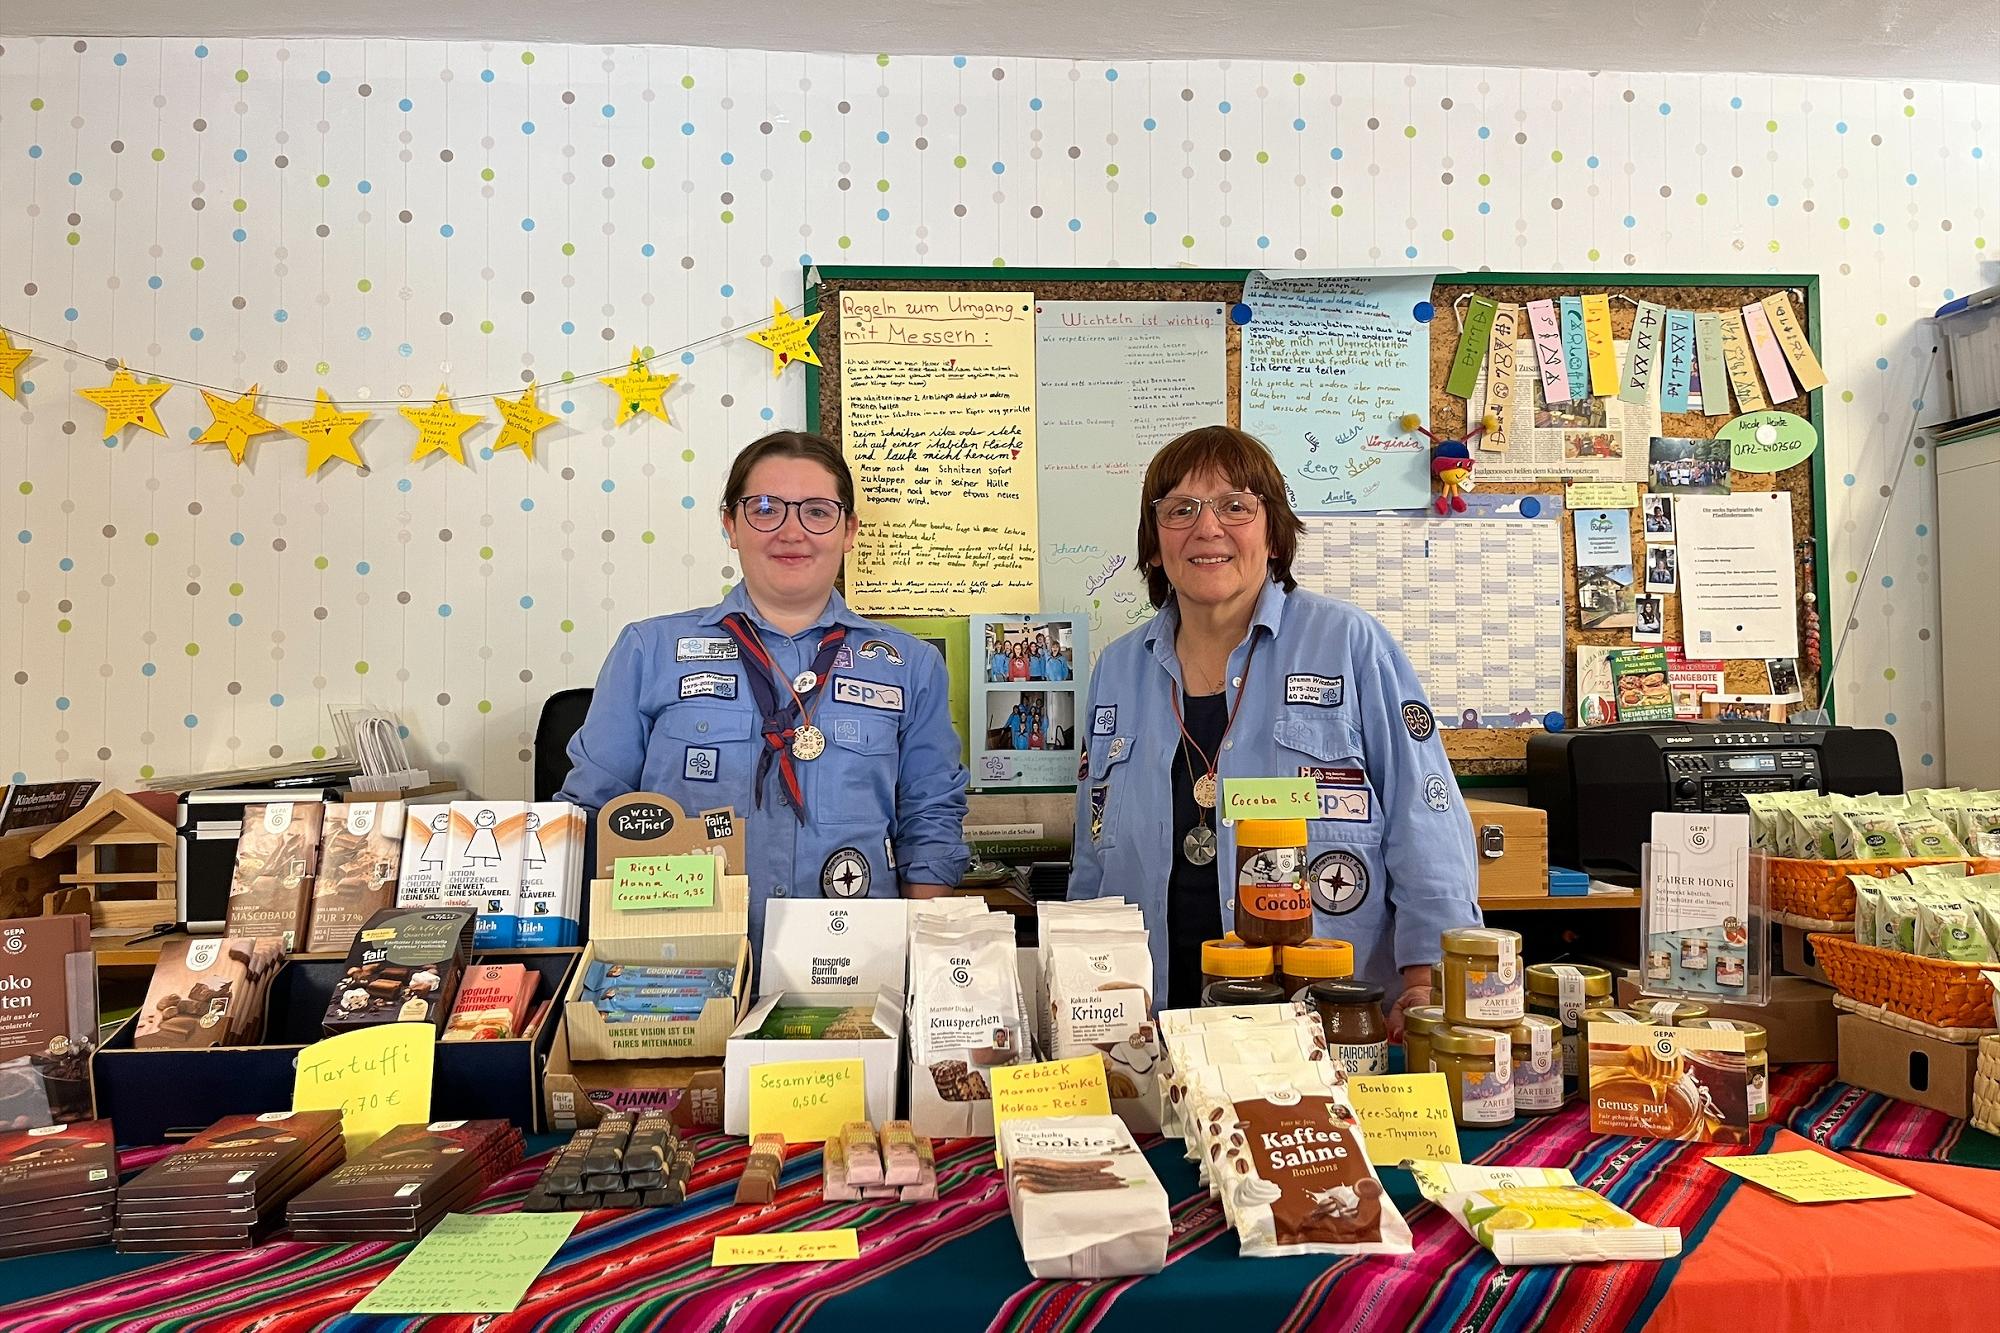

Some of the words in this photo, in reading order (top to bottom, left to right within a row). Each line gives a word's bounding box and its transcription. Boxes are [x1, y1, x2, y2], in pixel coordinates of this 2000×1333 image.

[842, 296, 896, 322] Regeln
[906, 304, 939, 315] zum
[948, 295, 1013, 322] Umgang
[1061, 312, 1133, 327] Wichteln
[1141, 314, 1158, 326] ist
[1166, 314, 1214, 329] wichtig:
[844, 323, 878, 340] mit
[1290, 337, 1314, 347] mich
[1315, 349, 1334, 357] und
[1360, 349, 1381, 357] mich
[1309, 356, 1326, 364] und
[1250, 363, 1266, 373] Ich
[1269, 364, 1291, 373] lerne
[1315, 365, 1346, 375] teilen
[1251, 377, 1263, 386] Ich
[1296, 392, 1311, 401] und
[1321, 393, 1339, 402] das
[881, 427, 926, 439] Schnitzen
[1366, 435, 1421, 450] Virginia
[854, 451, 876, 461] und
[939, 464, 982, 475] Schnitzen
[988, 466, 1012, 475] sofort
[1303, 460, 1328, 473] Lea
[935, 477, 943, 486] in
[986, 478, 1009, 488] Hülle
[1085, 554, 1123, 590] Charlotte
[1669, 673, 1718, 682] SANGEBOTE
[837, 682, 876, 702] rsp
[1300, 694, 1319, 702] Jahre
[1621, 708, 1673, 718] HEIMSERVICE
[1231, 793, 1277, 806] Cocoba
[630, 808, 663, 817] WELT
[618, 816, 672, 831] Partner
[714, 825, 732, 838] bio
[630, 863, 671, 876] Riegel
[620, 879, 662, 887] Hanna
[676, 873, 704, 884] 1,70
[1657, 875, 1695, 886] FAIRER
[1698, 878, 1734, 888] HONIG
[683, 887, 705, 898] 1,95
[1255, 893, 1311, 911] Cocoba
[232, 911, 296, 922] MASCOBADO
[317, 913, 337, 923] PUR
[340, 912, 363, 922] 37%
[4, 928, 26, 936] GEPA
[362, 950, 388, 961] fair
[812, 957, 851, 967] Knusprige
[950, 957, 971, 966] GEPA
[811, 975, 859, 986] Sesamriegel
[462, 987, 493, 997] yogurt
[460, 995, 513, 1004] strawberry
[1071, 996, 1088, 1004] Kokos
[1484, 998, 1510, 1006] ZARTE
[1072, 1003, 1124, 1023] Kringel
[930, 1014, 1000, 1030] Knusperchen
[609, 1028, 639, 1037] UNSERE
[640, 1028, 666, 1036] VISION
[668, 1027, 681, 1035] IST
[683, 1027, 695, 1035] EIN
[1653, 1030, 1677, 1038] GEPA
[613, 1040, 639, 1048] FAIRES
[641, 1039, 695, 1048] MITEINANDER.
[304, 1045, 411, 1084] Tartuffi
[1013, 1062, 1070, 1080] Gebäck
[760, 1068, 850, 1088] Sesamriegel
[1357, 1083, 1413, 1094] Bonbons
[1518, 1087, 1543, 1095] ZARTE
[616, 1091, 667, 1106] HANNA
[1483, 1100, 1505, 1108] ZARTE
[1597, 1098, 1639, 1111] Genuss
[1426, 1108, 1448, 1120] 2,40
[1017, 1137, 1116, 1147] Cookies
[1261, 1127, 1343, 1151] Kaffee
[1270, 1142, 1348, 1170] Sahne
[1426, 1144, 1451, 1157] 2,60
[1292, 1164, 1338, 1178] Bonbons
